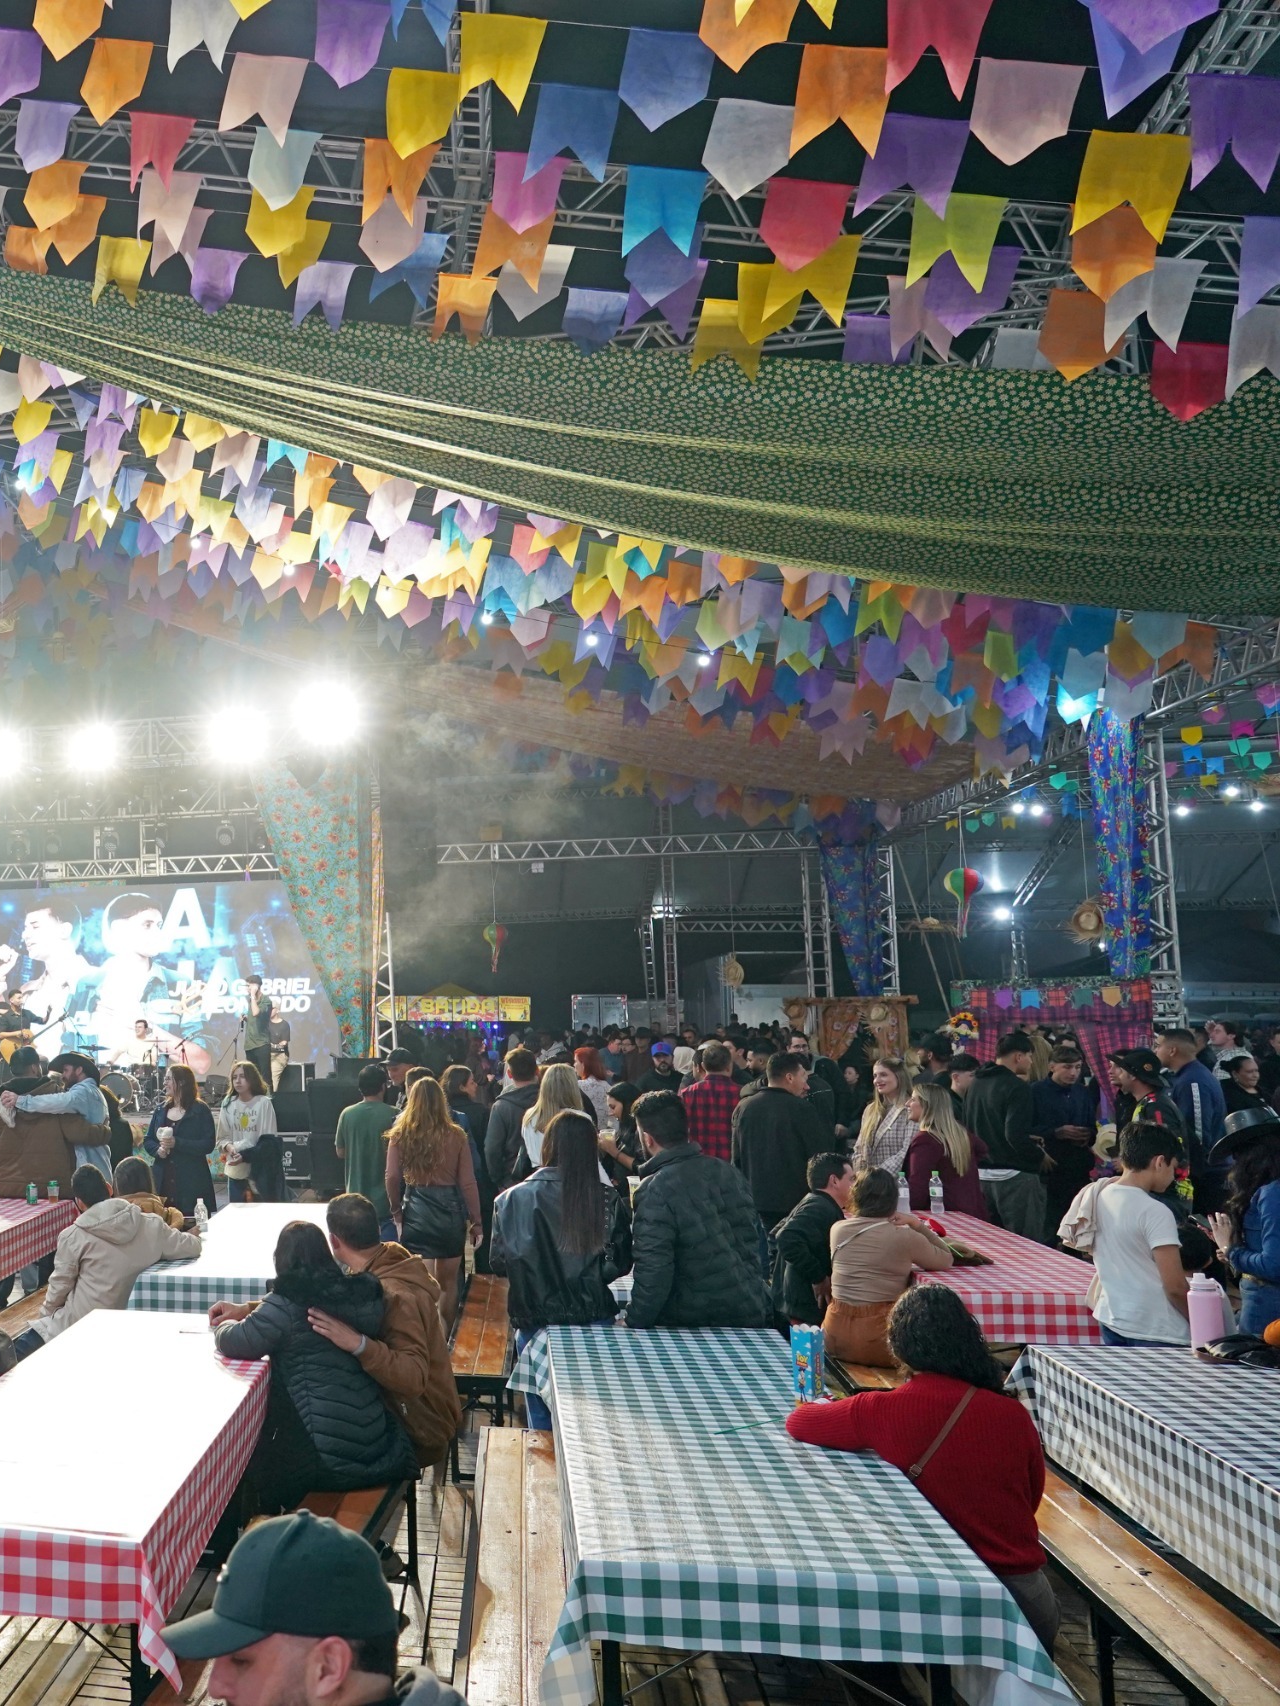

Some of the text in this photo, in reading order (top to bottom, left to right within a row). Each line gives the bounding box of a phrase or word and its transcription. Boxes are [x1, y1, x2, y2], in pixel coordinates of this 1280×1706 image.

[169, 977, 315, 997] JUO GBRIEL
[203, 996, 311, 1014] EONDO
[420, 998, 494, 1014] BATIDA
